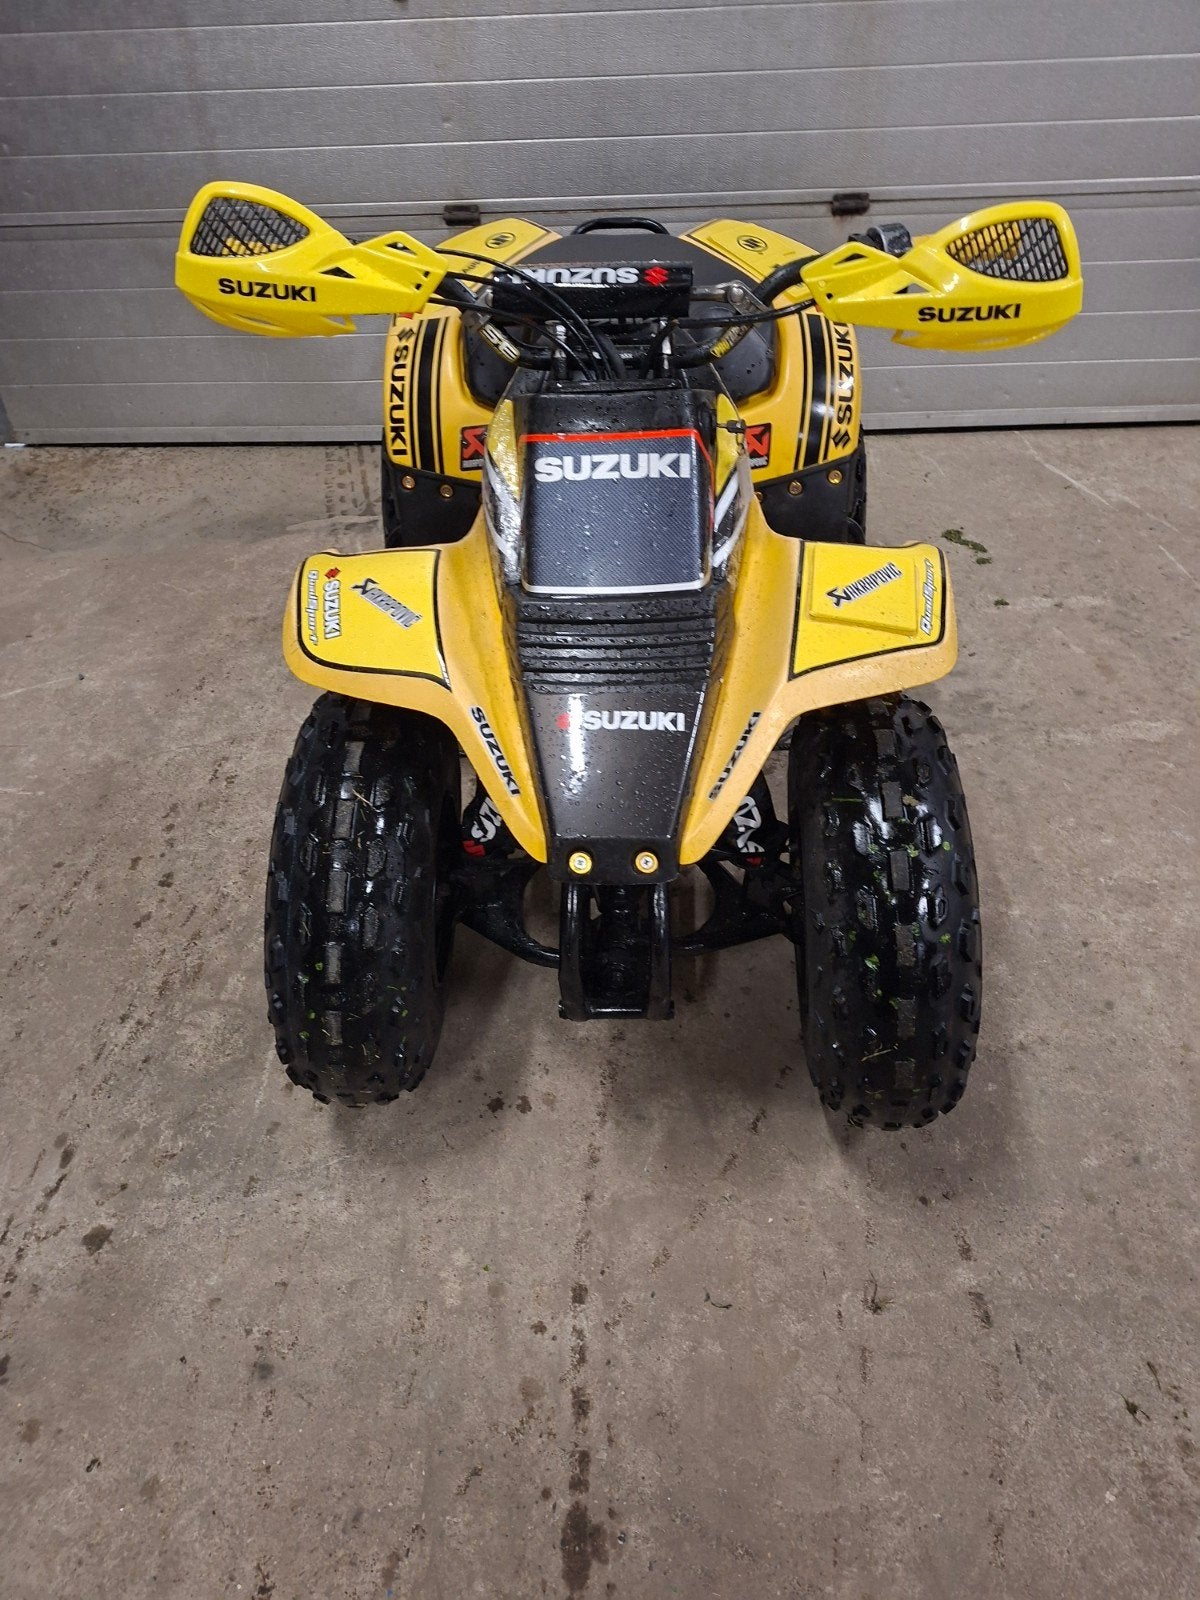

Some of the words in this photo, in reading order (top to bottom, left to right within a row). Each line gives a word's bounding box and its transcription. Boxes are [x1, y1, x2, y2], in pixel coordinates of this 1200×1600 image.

[217, 278, 317, 302] SUZUKI
[918, 303, 1022, 323] SUZUKI
[833, 322, 854, 426] SUZUKI
[389, 345, 410, 457] SUZUKI
[534, 453, 691, 483] SUZUKI
[323, 579, 342, 640] SUZUKI
[582, 710, 686, 732] SUZUKI
[470, 705, 522, 797] SUZUKI
